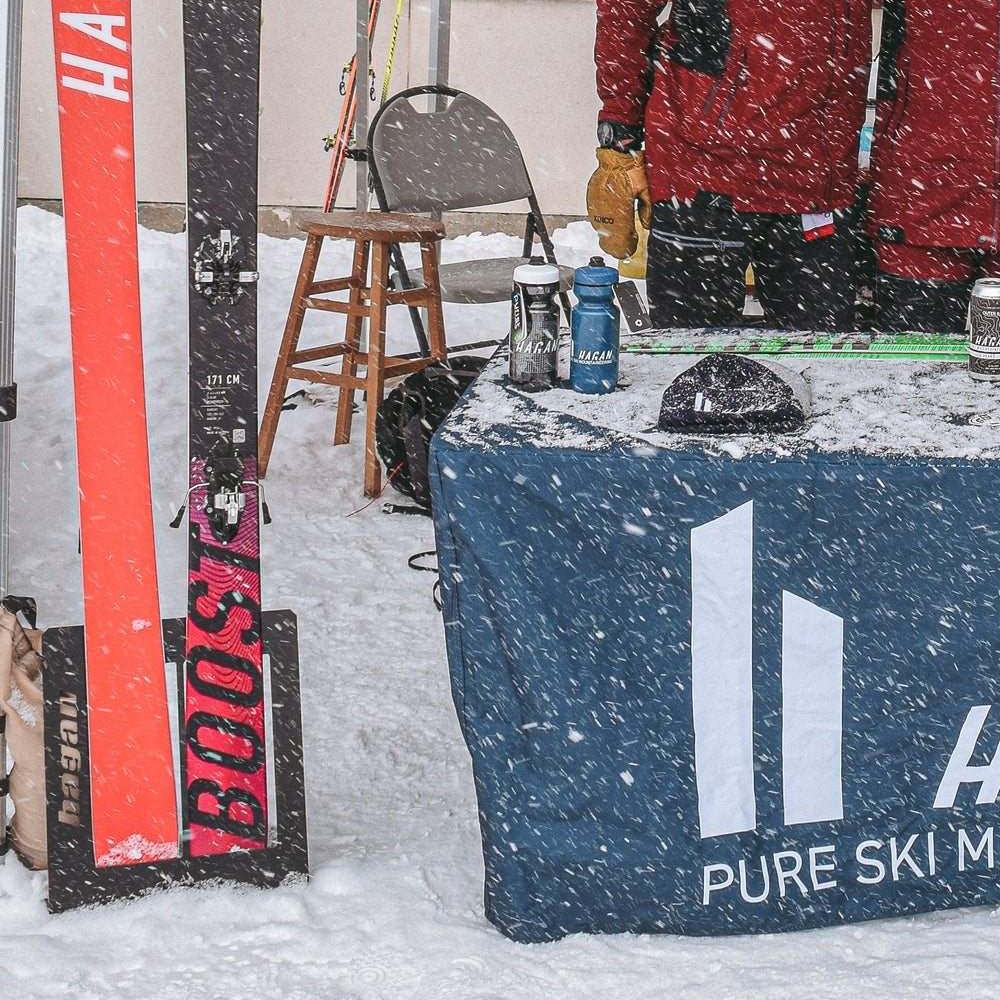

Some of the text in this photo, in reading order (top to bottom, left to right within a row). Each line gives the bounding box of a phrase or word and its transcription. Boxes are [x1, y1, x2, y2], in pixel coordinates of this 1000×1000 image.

[515, 339, 559, 354] HAGAN
[578, 350, 614, 361] HAGAN
[206, 374, 240, 385] 171 CM
[186, 522, 267, 842] BOOST
[58, 690, 82, 826] hagan
[701, 845, 837, 906] PURE
[854, 831, 938, 885] SKI
